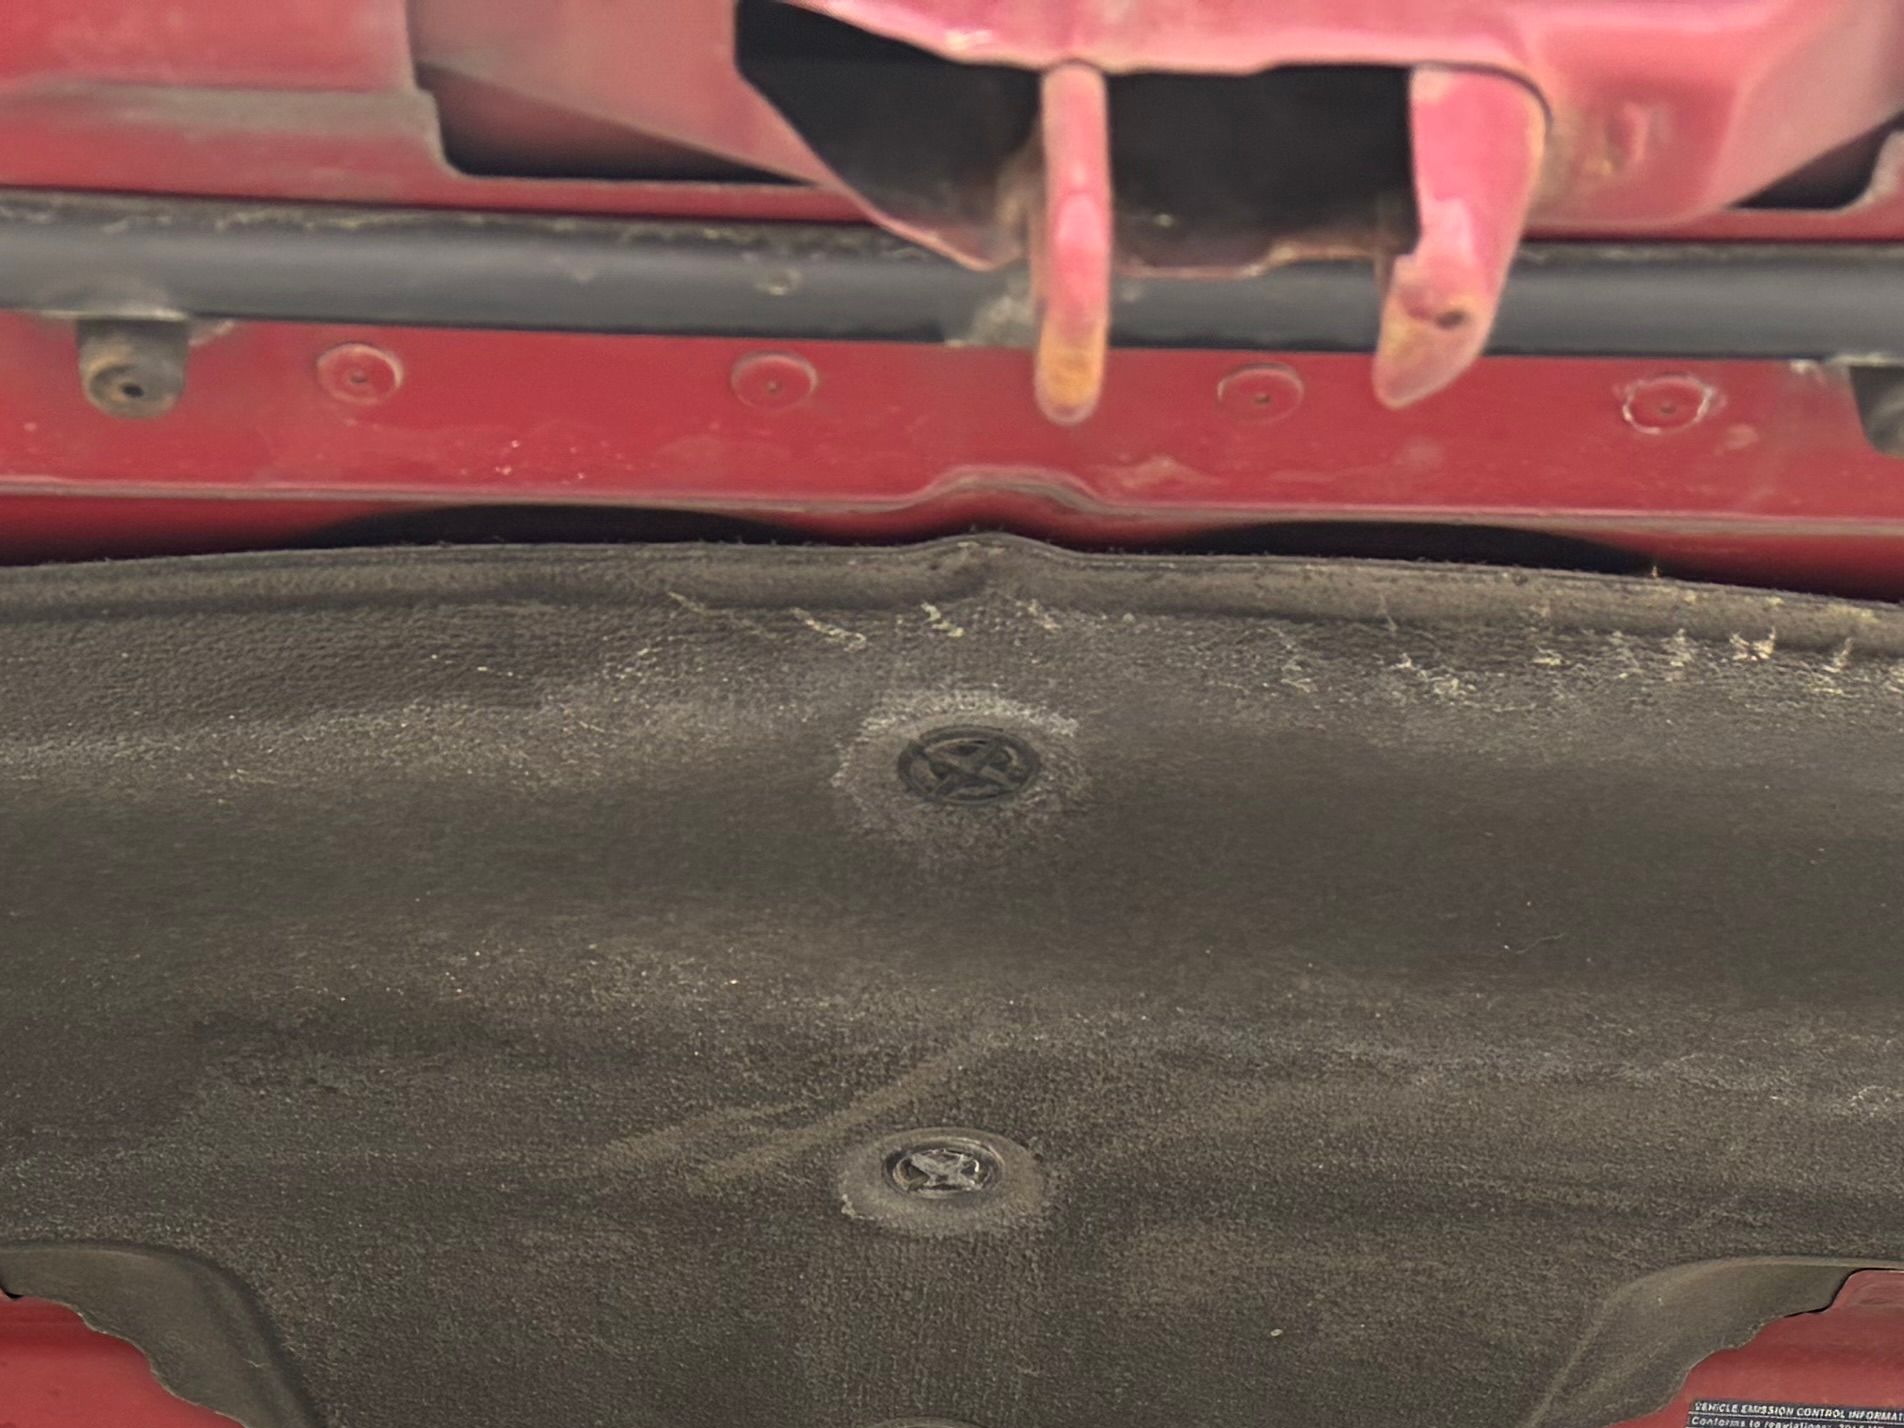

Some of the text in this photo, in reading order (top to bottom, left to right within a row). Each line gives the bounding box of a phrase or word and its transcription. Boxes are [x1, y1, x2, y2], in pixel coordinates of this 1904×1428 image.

[1695, 1402, 1737, 1413] VEHICLE
[1741, 1404, 1794, 1416] EMISSION
[1797, 1407, 1845, 1418] CONTROL
[1691, 1416, 1745, 1428] Conforms
[1749, 1419, 1761, 1428] to
